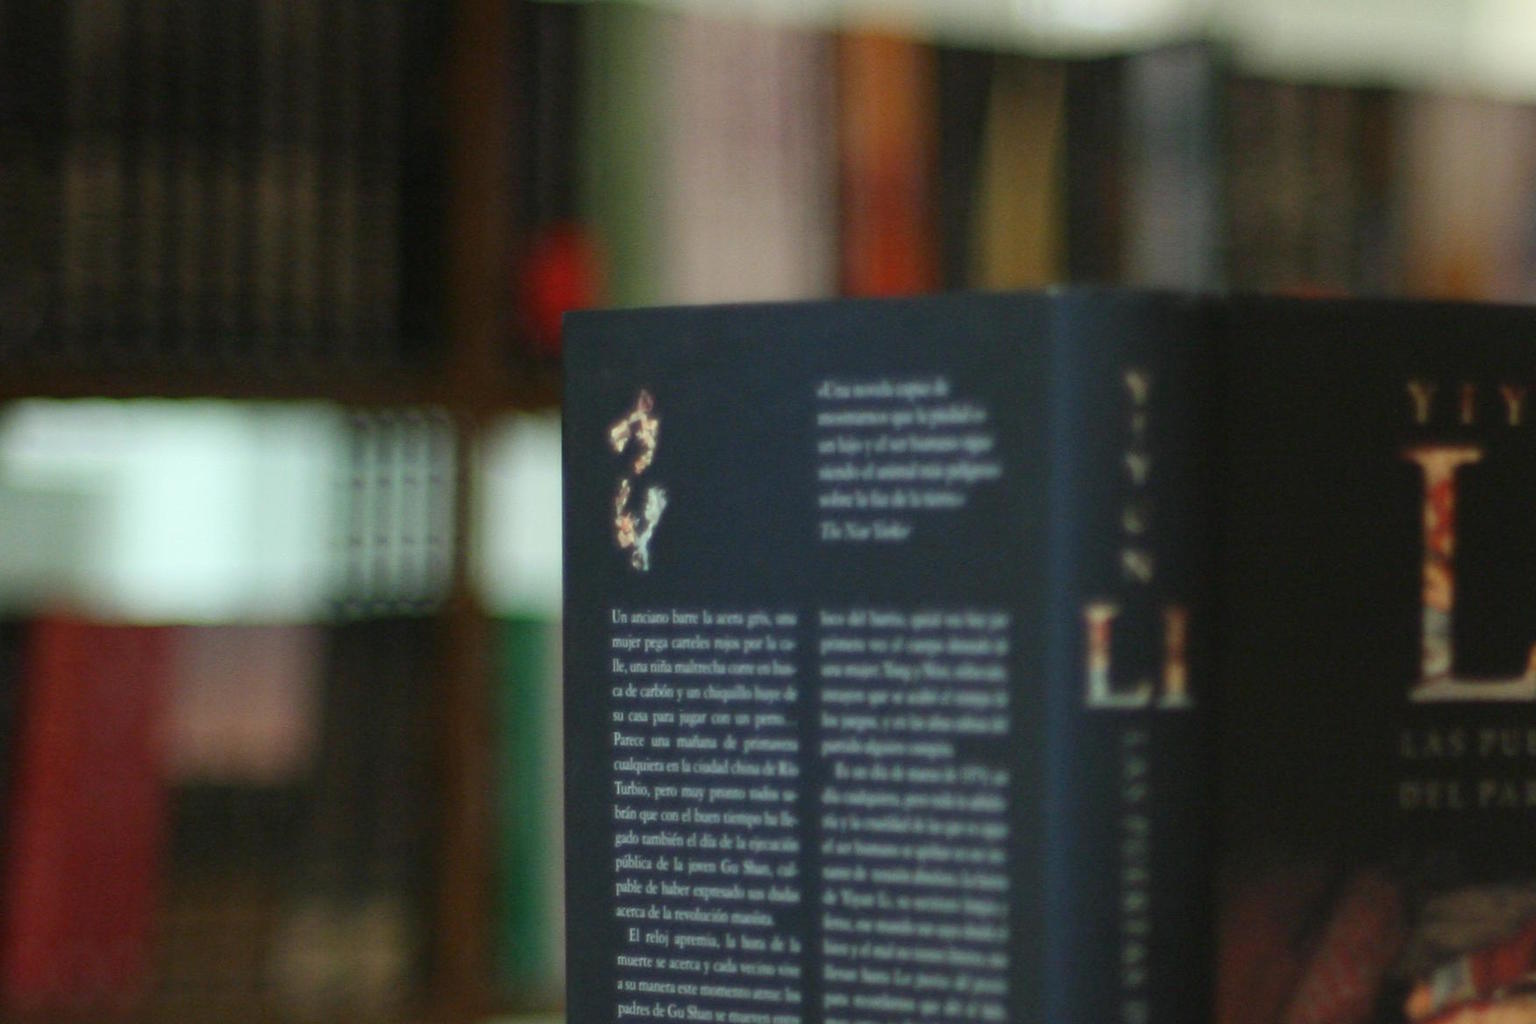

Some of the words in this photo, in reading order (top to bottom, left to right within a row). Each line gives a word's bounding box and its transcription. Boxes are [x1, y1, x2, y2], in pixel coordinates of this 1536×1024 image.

[612, 609, 628, 623] Un
[631, 613, 669, 624] anciano
[672, 609, 699, 624] barre
[612, 638, 641, 651] mujer
[644, 638, 668, 652] pega
[1084, 602, 1192, 709] LI
[612, 658, 628, 674] lle,
[630, 663, 648, 673] una
[650, 660, 672, 673] niña
[612, 687, 623, 697] ca
[625, 683, 637, 697] de
[640, 684, 674, 698] carbón
[676, 688, 683, 702] y
[612, 712, 623, 721] su
[628, 712, 648, 722] casa
[652, 712, 674, 726] para
[613, 732, 645, 746] Parece
[651, 737, 670, 747] una
[1401, 729, 1466, 757] LAS
[613, 758, 664, 774] cualquiera
[666, 762, 679, 772] en
[681, 759, 691, 773] la
[614, 781, 650, 796] Turbio,
[654, 786, 677, 800] pero
[1402, 778, 1468, 809] DEL
[614, 805, 637, 819] brán
[639, 810, 657, 824] que
[660, 811, 679, 822] con
[681, 808, 691, 822] el
[615, 830, 639, 847] gado
[642, 832, 684, 846] también
[686, 833, 696, 847] el
[615, 854, 653, 872] pública
[656, 856, 669, 871] de
[673, 857, 684, 871] la
[615, 878, 642, 896] pable
[645, 880, 659, 894] de
[661, 881, 691, 896] haber
[615, 907, 645, 918] acerca
[647, 904, 660, 919] de
[663, 905, 672, 920] la
[629, 928, 640, 942] El
[645, 930, 669, 946] reloj
[617, 956, 653, 967] muerte
[656, 958, 666, 968] se
[617, 980, 623, 990] a
[625, 981, 636, 991] su
[638, 981, 675, 993] manera
[677, 984, 698, 995] este
[617, 1001, 650, 1017] padres
[652, 1002, 664, 1017] de
[667, 1004, 685, 1019] Gu
